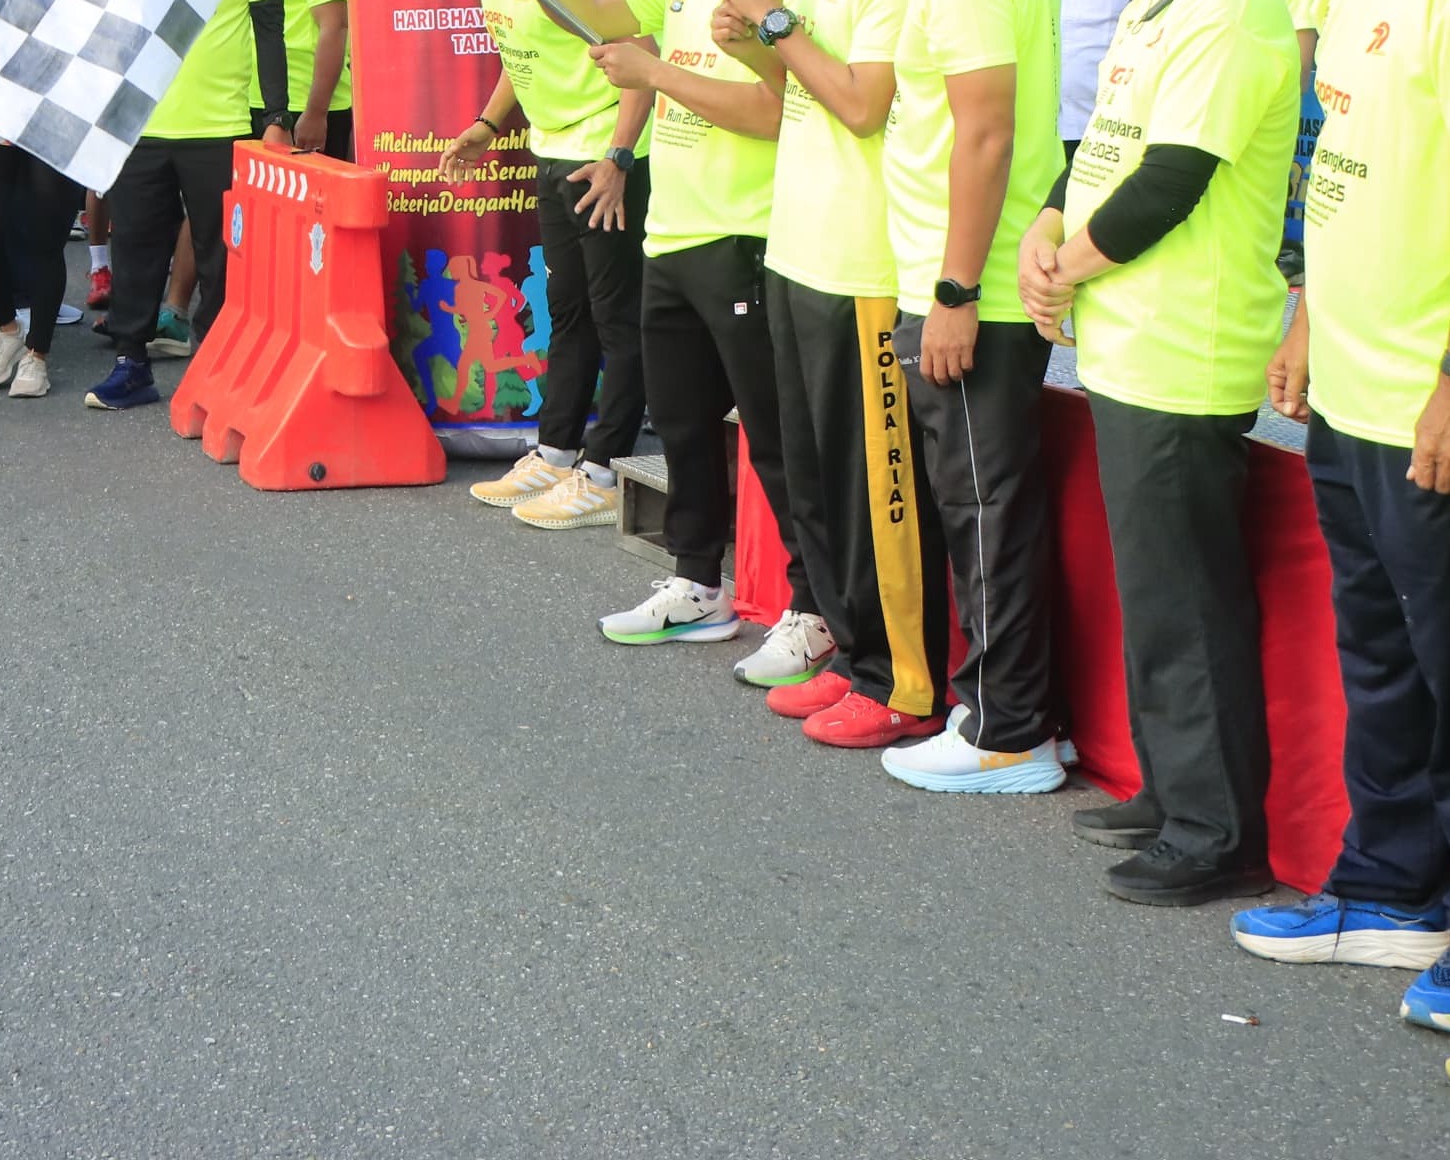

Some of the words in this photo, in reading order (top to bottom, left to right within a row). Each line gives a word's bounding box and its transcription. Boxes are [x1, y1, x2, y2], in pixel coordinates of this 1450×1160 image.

[394, 8, 434, 31] HARI
[703, 53, 718, 69] TO
[1332, 89, 1352, 115] TO
[666, 108, 681, 124] Run
[877, 331, 897, 431] POLDA
[888, 448, 904, 524] RIAU
